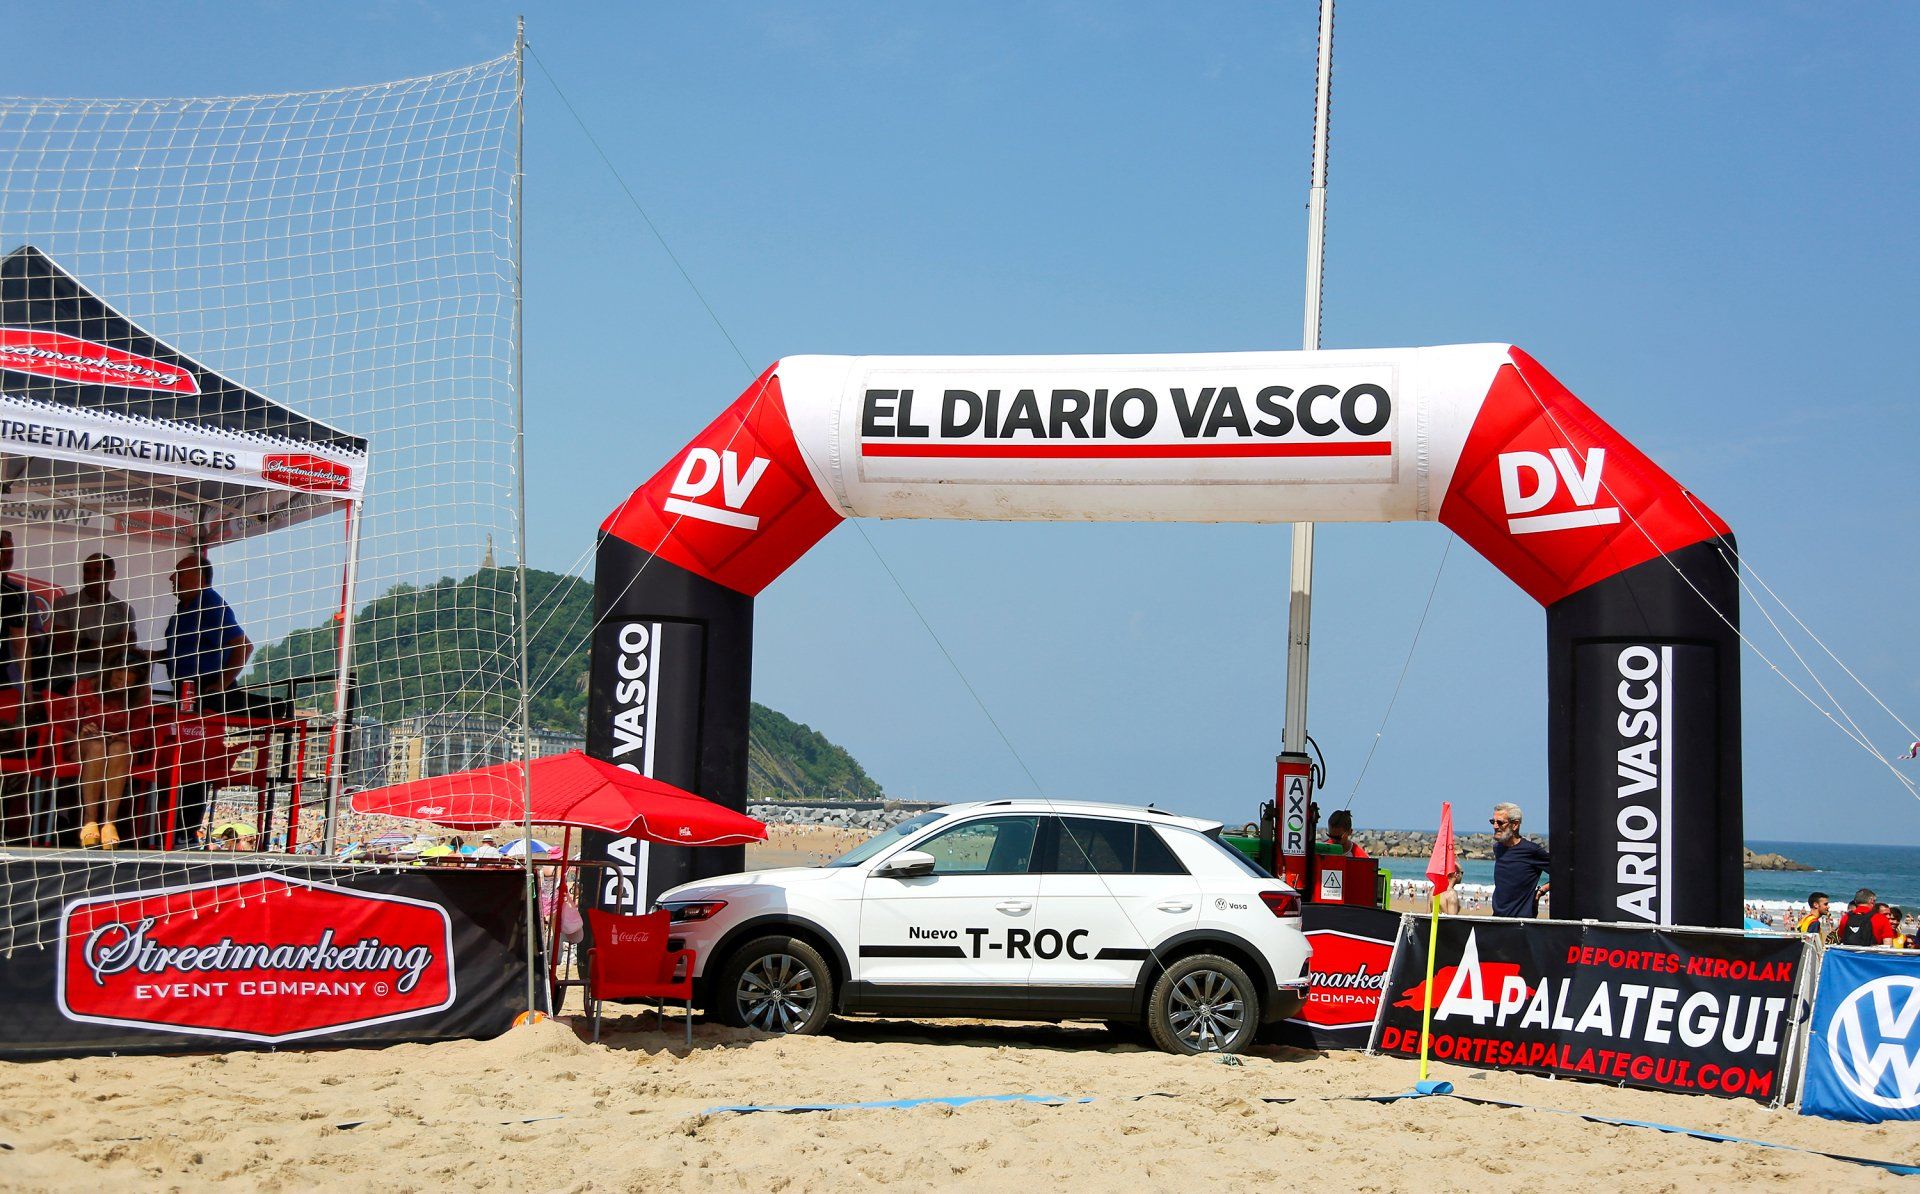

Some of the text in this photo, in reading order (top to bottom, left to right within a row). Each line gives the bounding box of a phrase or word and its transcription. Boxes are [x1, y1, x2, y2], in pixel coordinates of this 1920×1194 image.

[45, 361, 136, 381] COMPANY
[862, 384, 1392, 439] EL DIARIO VASCO
[0, 419, 237, 471] TREETMARKETING.ES
[670, 447, 771, 509] DV
[1498, 447, 1606, 515] DV
[612, 622, 650, 758] VASCO
[1617, 645, 1658, 799] VASCO
[1287, 777, 1305, 850] AXOR
[82, 916, 434, 993] Streetmarketing
[909, 926, 1090, 961] Nuevo T-ROC
[1567, 945, 1793, 982] DEPORTES-KIROLAK
[136, 982, 229, 999] EVENT
[240, 981, 367, 996] COMPANY
[1310, 993, 1382, 1005] COMPAN
[1434, 926, 1786, 1056] APALATEGUI
[1381, 1026, 1774, 1098] DEPORTESAPALATEGUI.COM
